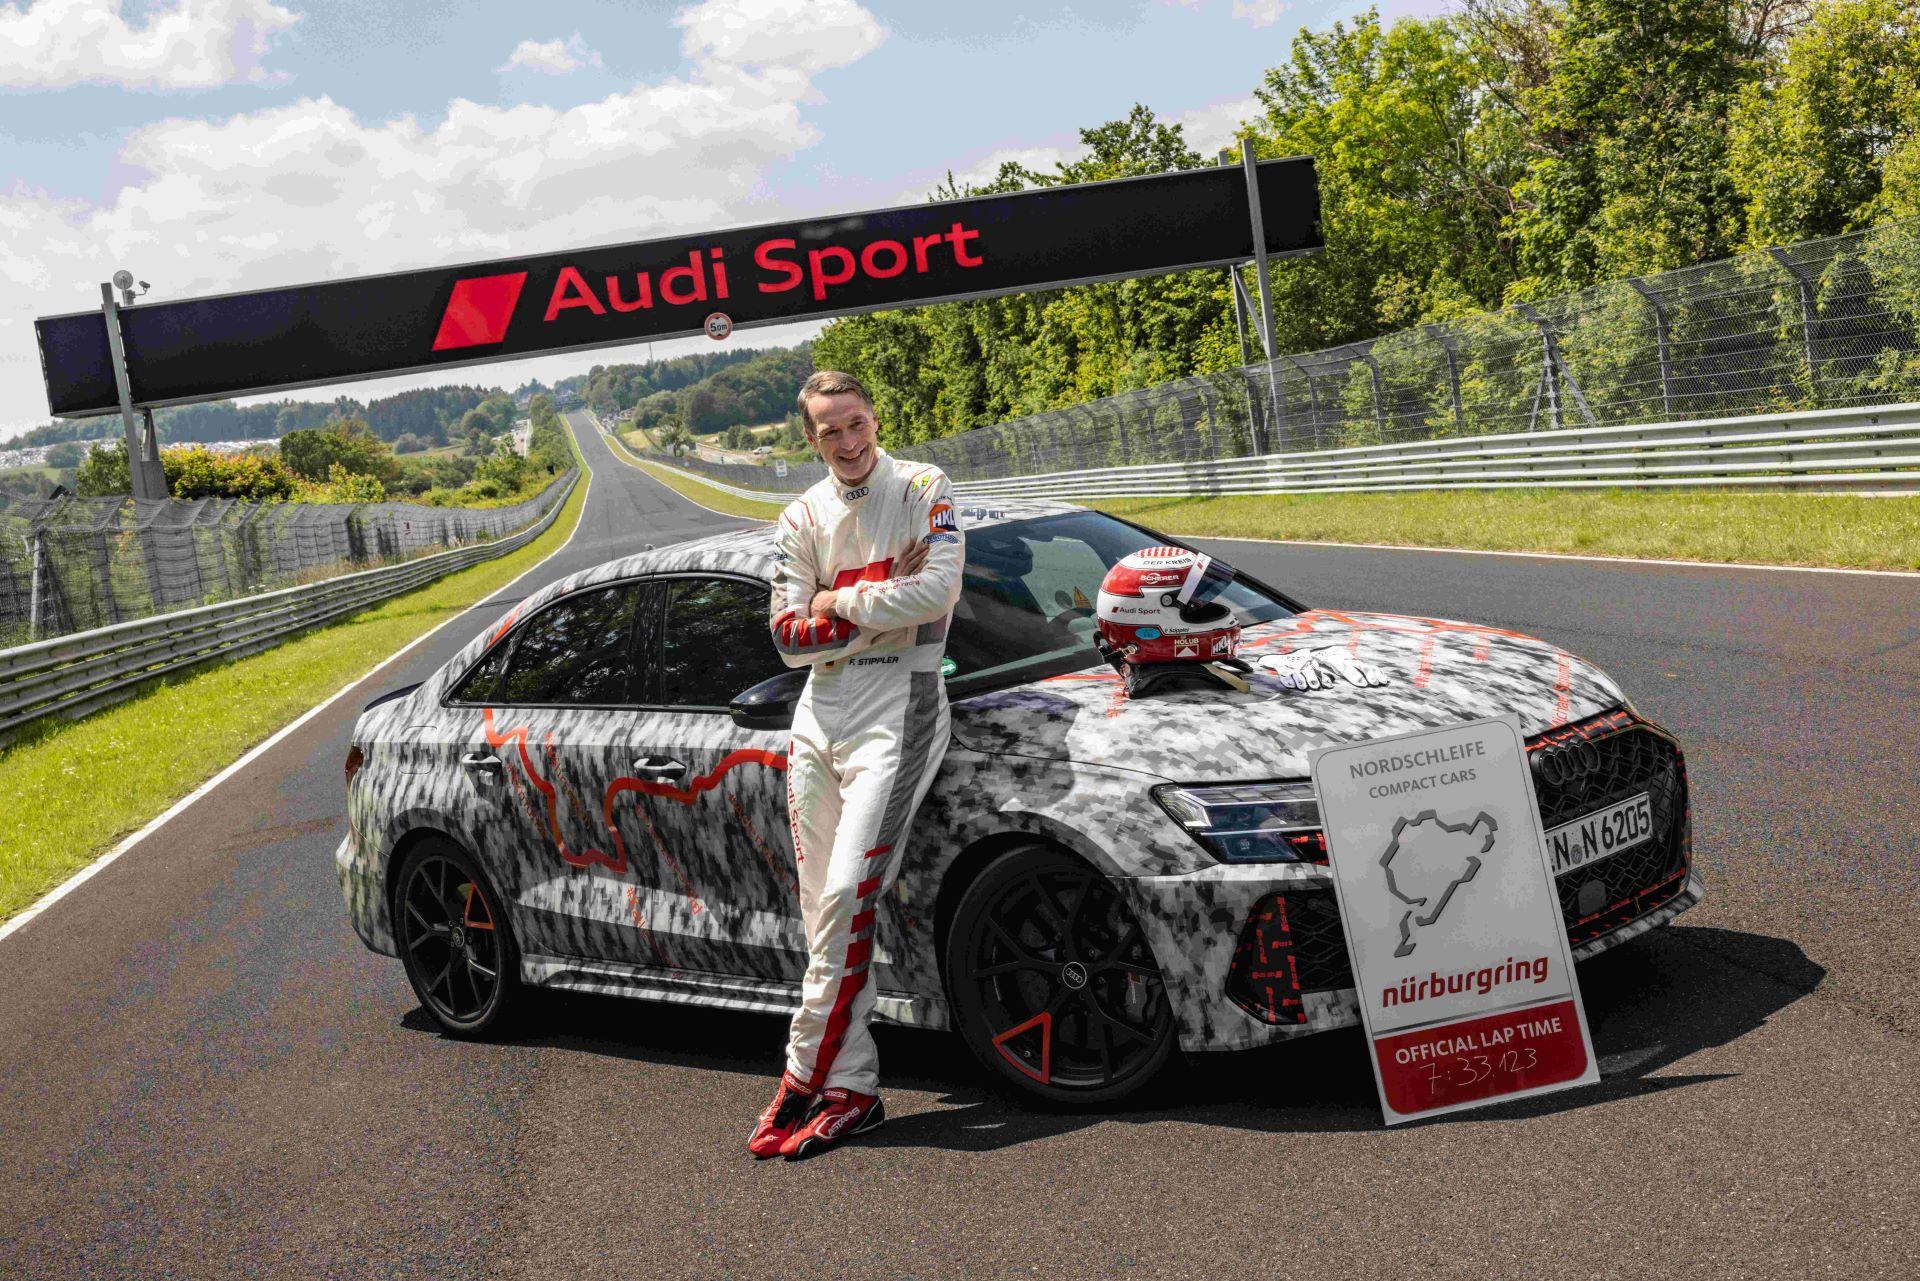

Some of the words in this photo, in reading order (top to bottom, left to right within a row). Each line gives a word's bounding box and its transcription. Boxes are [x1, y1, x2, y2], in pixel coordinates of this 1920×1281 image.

[543, 246, 731, 322] Audi
[754, 221, 984, 300] Sport
[933, 508, 956, 528] HKL
[1165, 557, 1192, 566] KREIS
[1138, 608, 1161, 616] Sport
[857, 655, 900, 666] STIPPLER
[1349, 740, 1486, 780] NORDSCHLEIFE
[1368, 775, 1438, 800] COMPACT
[1439, 768, 1477, 786] CARS
[791, 808, 805, 864] Sport
[1601, 800, 1650, 850] 6205
[1382, 956, 1549, 1008] nürburgring
[1395, 1030, 1478, 1065] OFFICIAL
[1480, 1026, 1514, 1049] LAP
[1516, 1017, 1563, 1042] TIME
